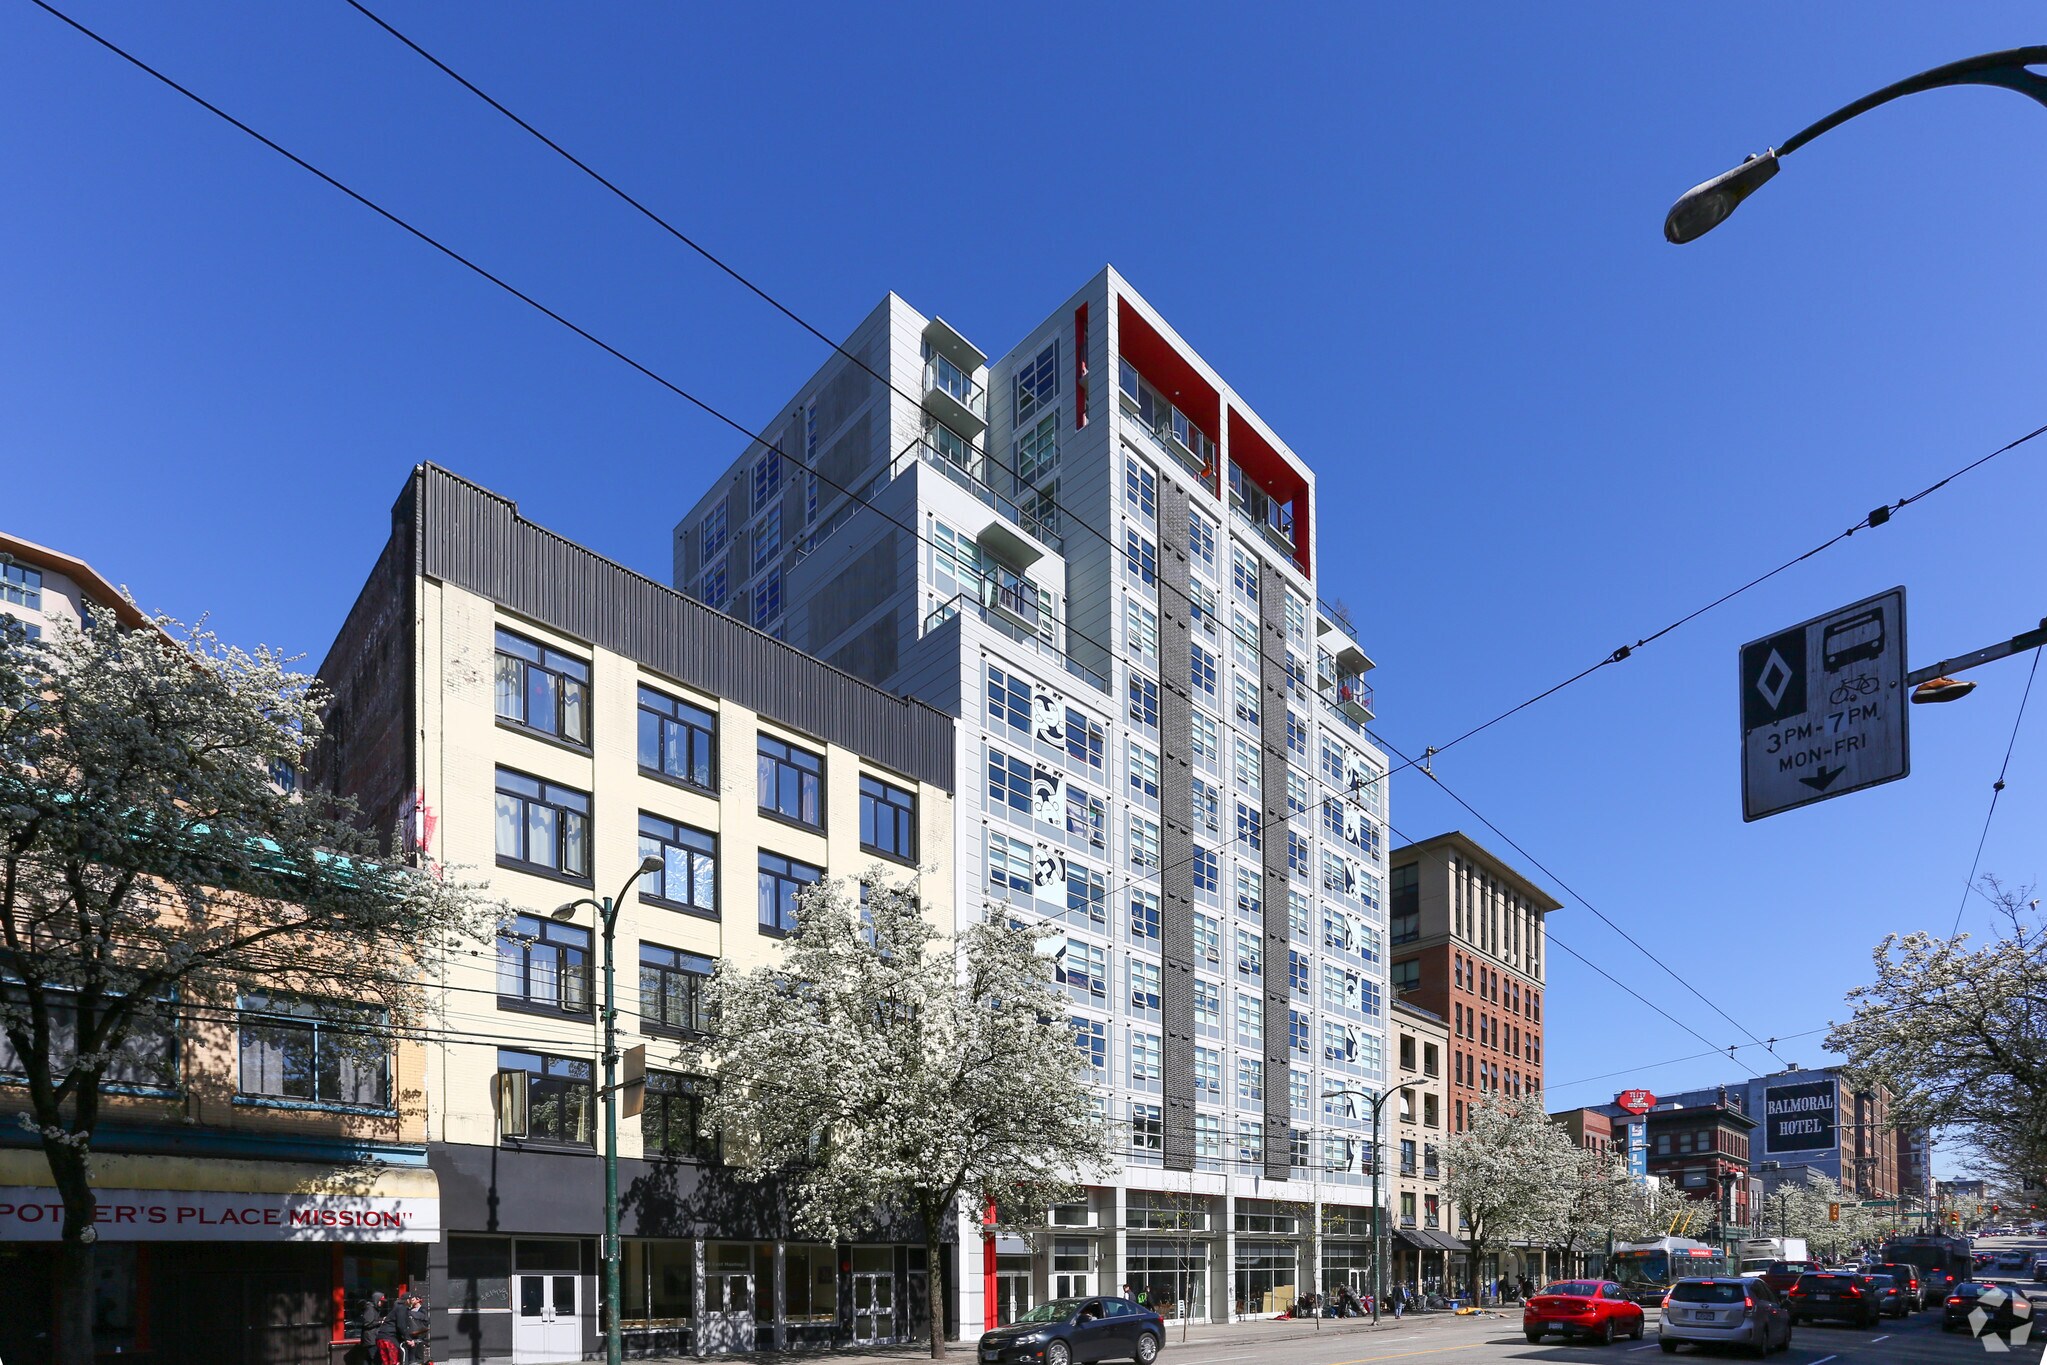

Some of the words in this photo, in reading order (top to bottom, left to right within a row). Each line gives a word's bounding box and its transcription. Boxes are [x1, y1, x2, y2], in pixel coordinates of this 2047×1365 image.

[1780, 733, 1866, 772] MON-FRI
[1767, 1095, 1833, 1115] BALMORAL
[1779, 1118, 1822, 1136] HOTEL
[0, 1203, 166, 1225] POTER'S
[177, 1207, 281, 1226] PLACE
